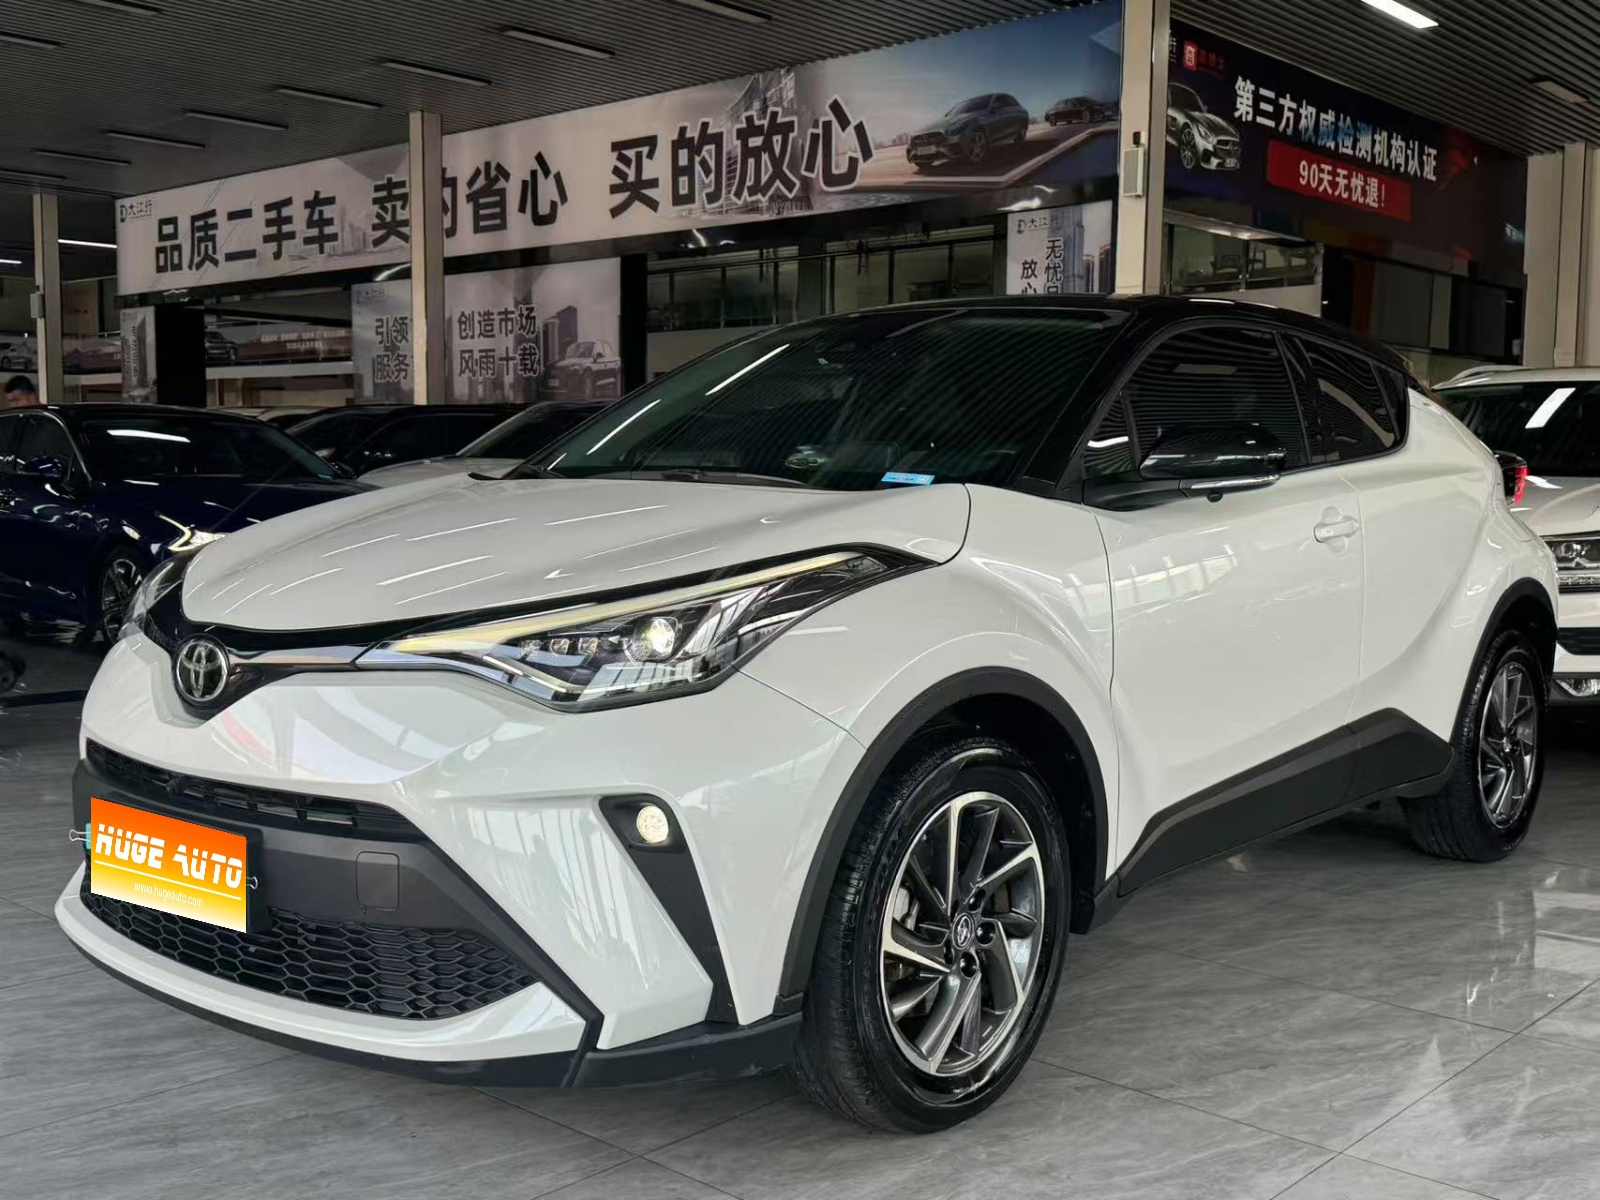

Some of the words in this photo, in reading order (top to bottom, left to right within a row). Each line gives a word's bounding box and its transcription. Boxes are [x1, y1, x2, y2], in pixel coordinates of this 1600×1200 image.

[1234, 76, 1438, 182] 第三方权威检测机构认证
[155, 190, 339, 274] 品质二手车
[609, 96, 875, 220] 买的放心
[1299, 160, 1386, 208] 90天无忧退!
[374, 316, 412, 346] 引领
[457, 305, 538, 342] 创造市场
[374, 353, 412, 383] 服务
[458, 345, 541, 378] 风雨十载
